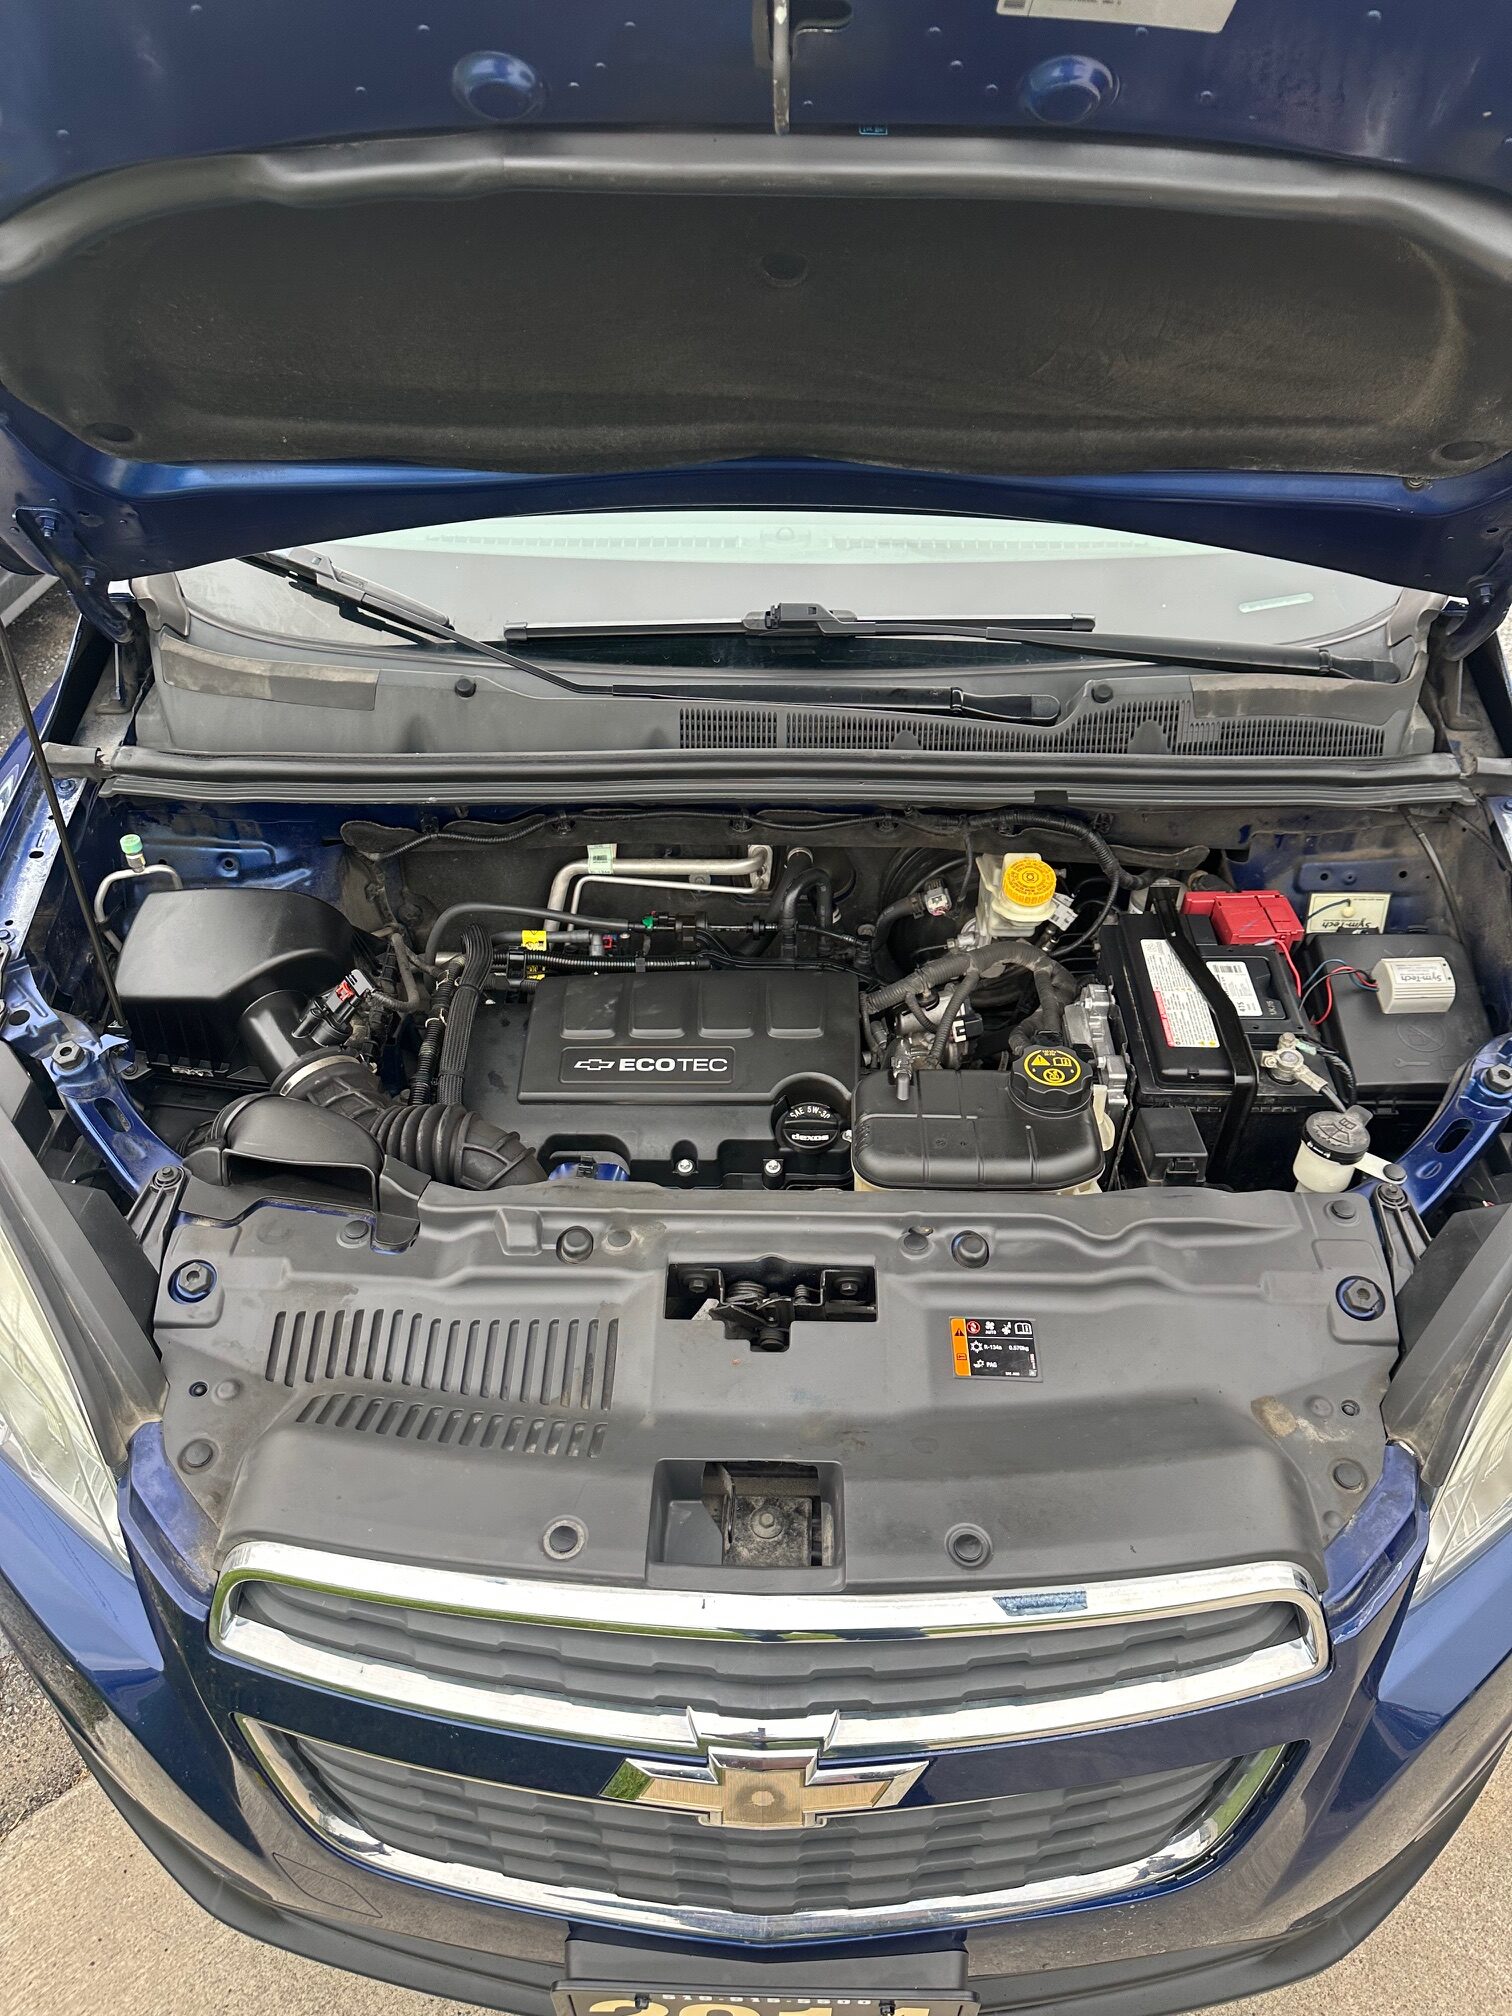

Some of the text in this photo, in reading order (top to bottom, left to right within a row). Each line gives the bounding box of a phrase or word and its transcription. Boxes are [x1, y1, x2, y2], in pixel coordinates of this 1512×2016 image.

[1401, 972, 1442, 982] Sym-Tech
[618, 1057, 728, 1072] ECOTEC
[791, 1133, 830, 1141] dexos
